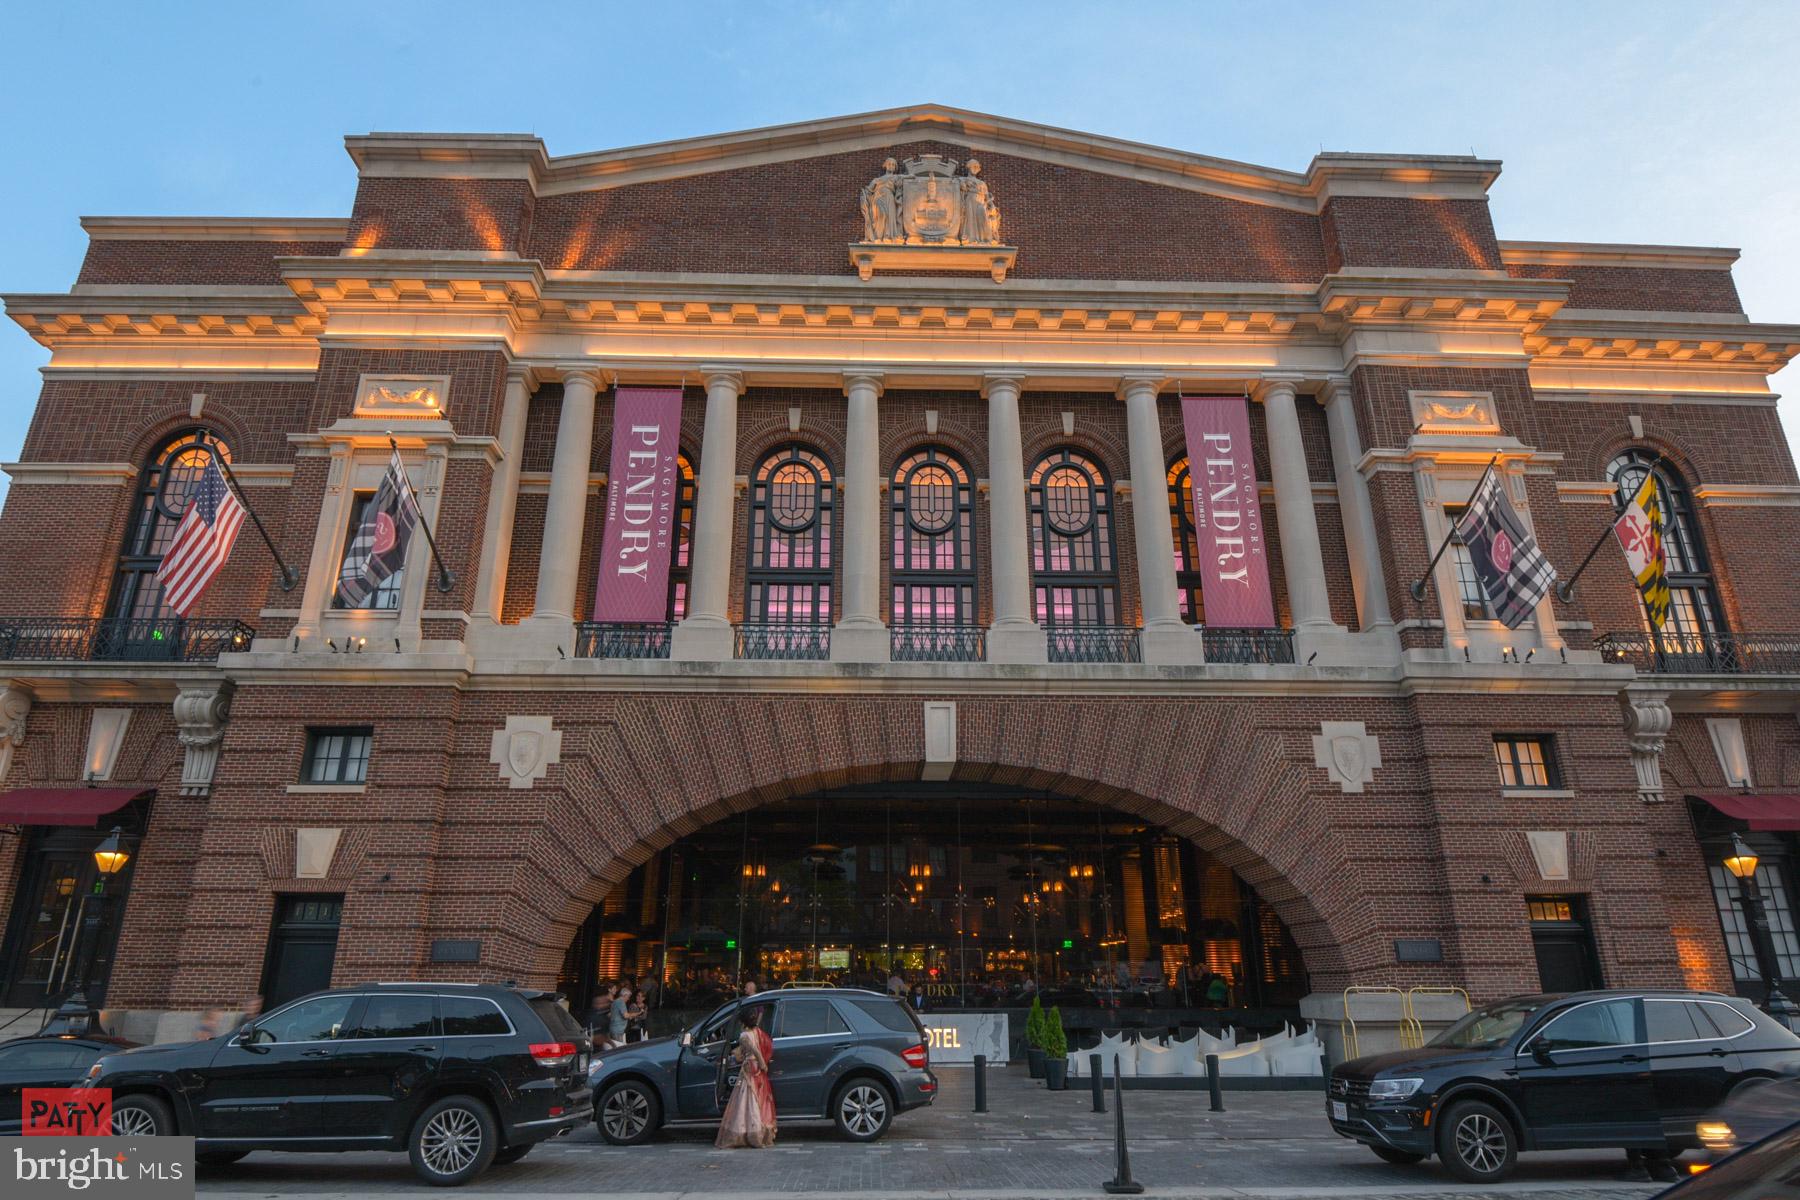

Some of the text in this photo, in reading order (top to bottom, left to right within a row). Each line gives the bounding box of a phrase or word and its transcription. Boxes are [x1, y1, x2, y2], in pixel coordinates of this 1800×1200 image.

[608, 480, 619, 522] BALTIMORE
[618, 424, 660, 582] PENDRY
[657, 455, 673, 548] SAGAMORE
[1196, 487, 1207, 529] BALTIMORE
[1203, 432, 1250, 588] PENDRY
[1241, 463, 1261, 555] SAGAMORE
[924, 1028, 961, 1048] OTEL
